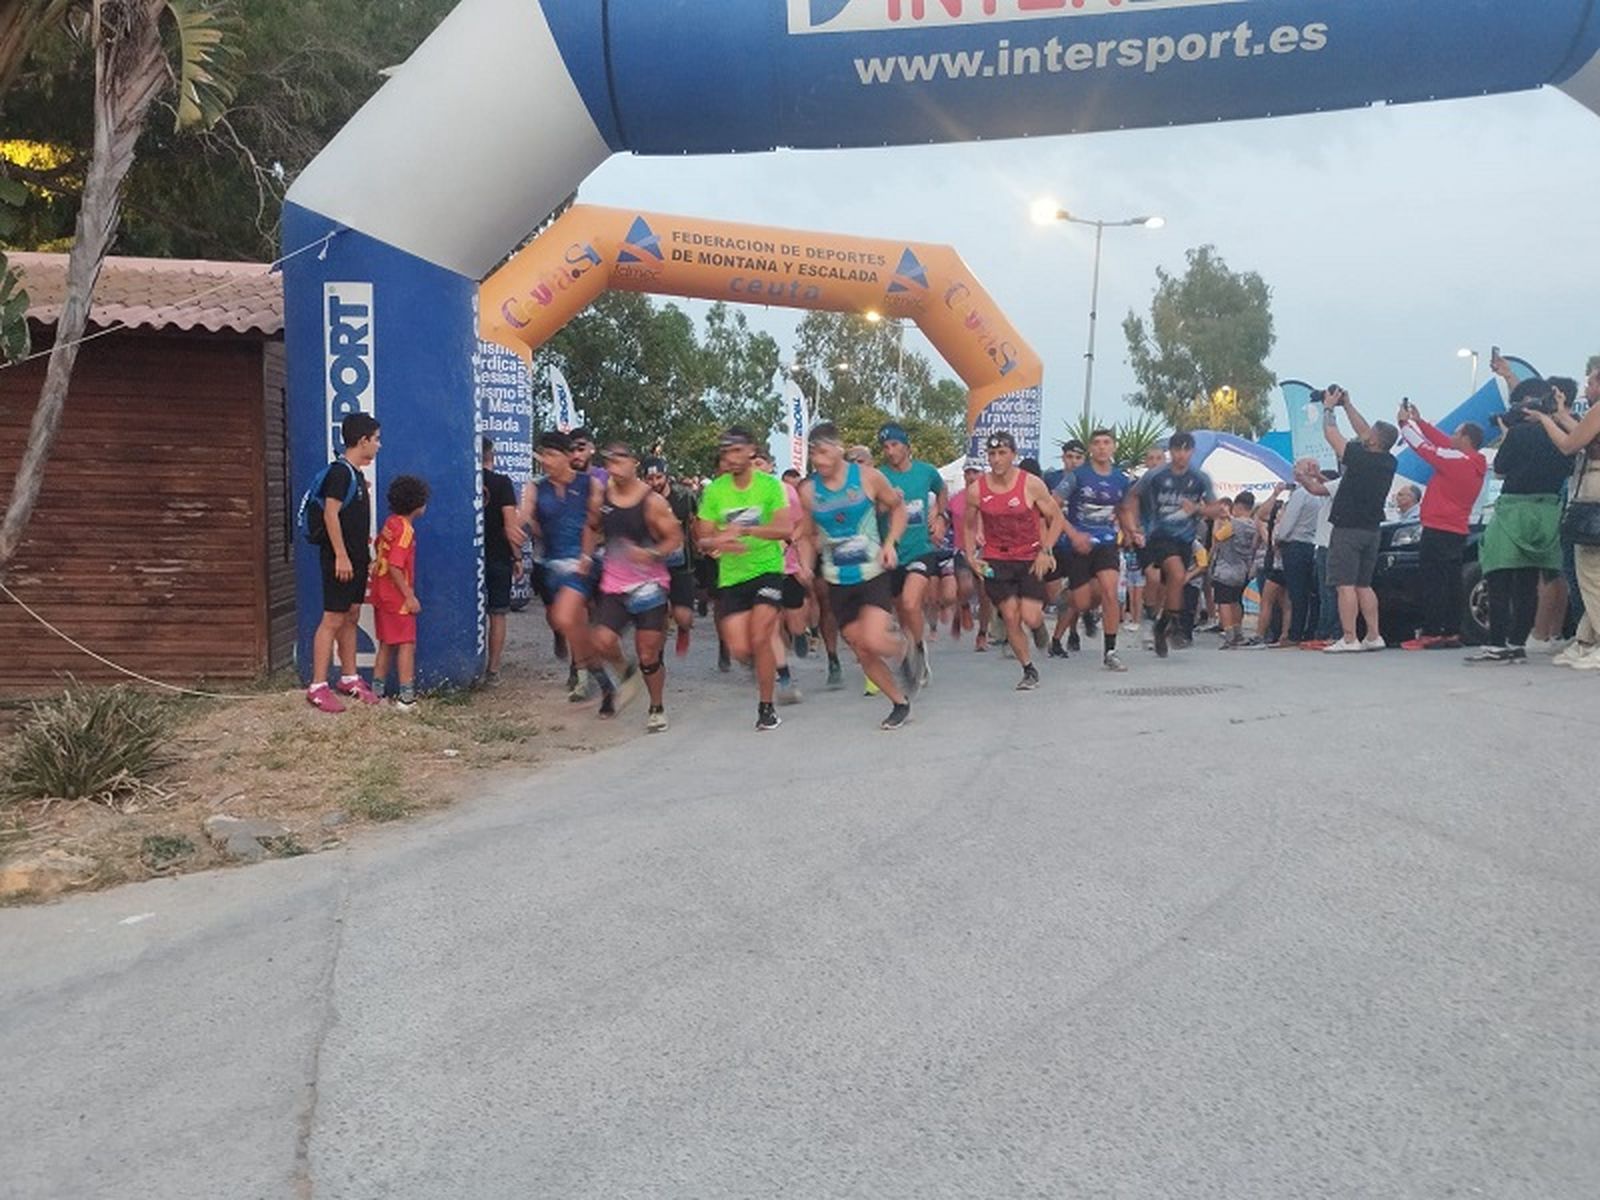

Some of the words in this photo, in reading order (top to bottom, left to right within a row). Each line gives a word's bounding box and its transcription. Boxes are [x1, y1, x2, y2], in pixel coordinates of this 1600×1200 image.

[854, 21, 1328, 84] www.intersport.es
[671, 248, 693, 263] DE
[784, 260, 794, 274] Y
[799, 264, 879, 283] ESCALADA
[672, 230, 775, 255] FEDERACION
[780, 244, 801, 257] DE
[805, 247, 886, 267] DEPORTES
[728, 275, 822, 301] ceuta
[480, 415, 520, 432] alada
